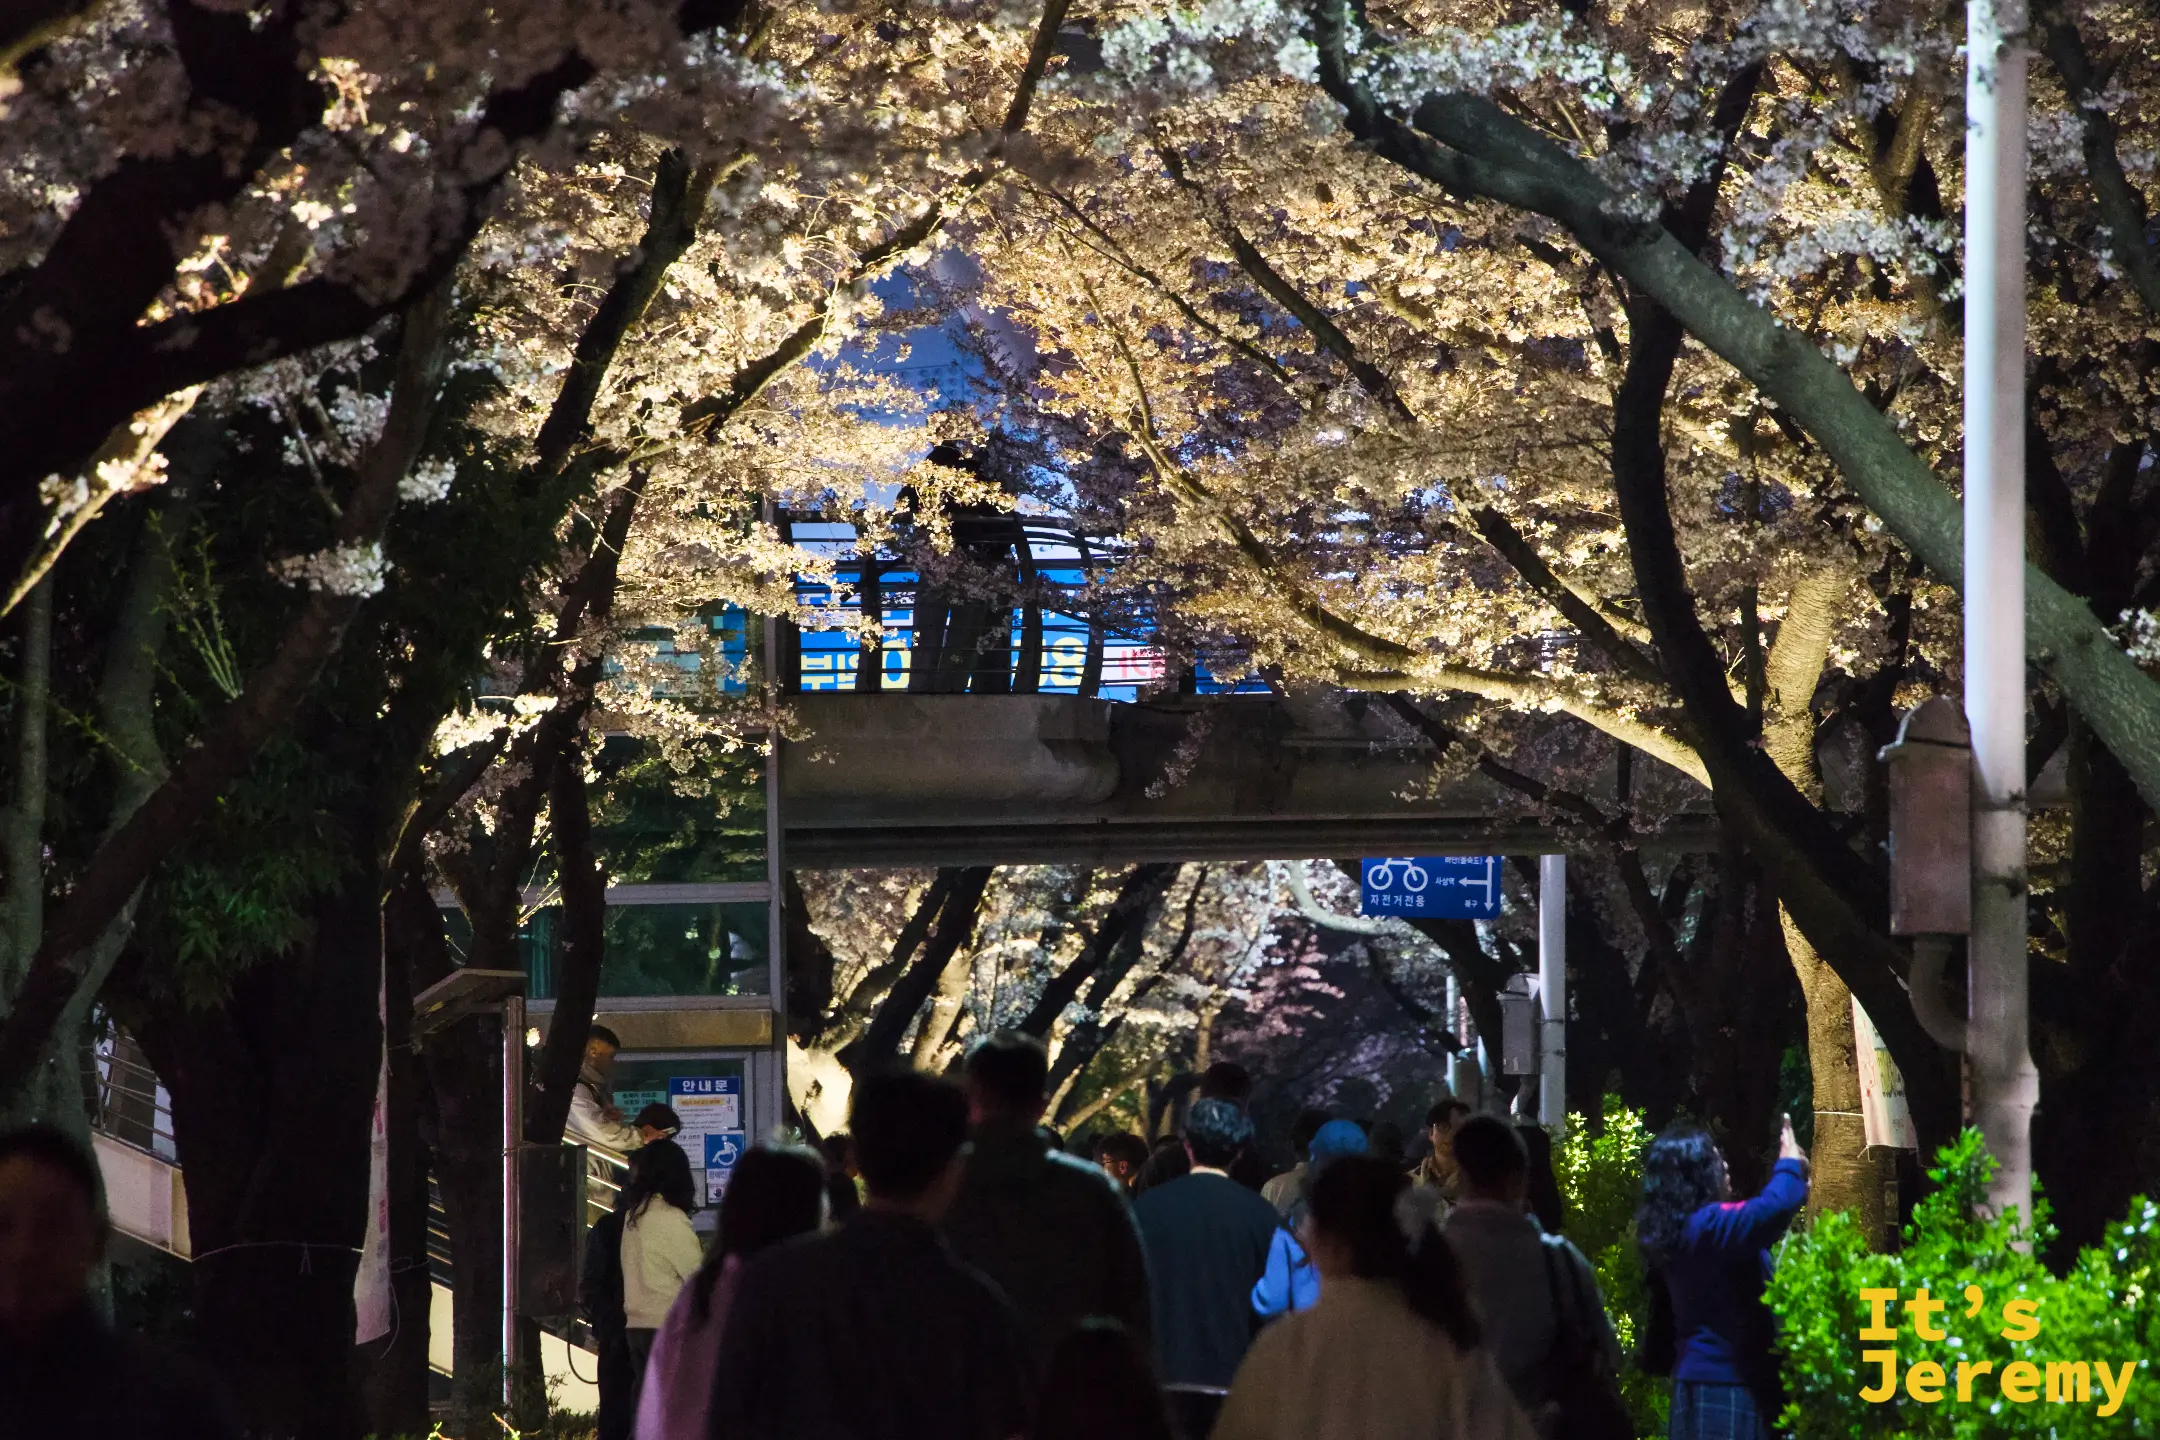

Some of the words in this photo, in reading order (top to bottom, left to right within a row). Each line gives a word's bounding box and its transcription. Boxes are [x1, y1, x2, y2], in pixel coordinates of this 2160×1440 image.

[1435, 876, 1455, 887] 사상역
[1370, 894, 1426, 907] 자전거전용
[682, 1079, 728, 1093] 안내문
